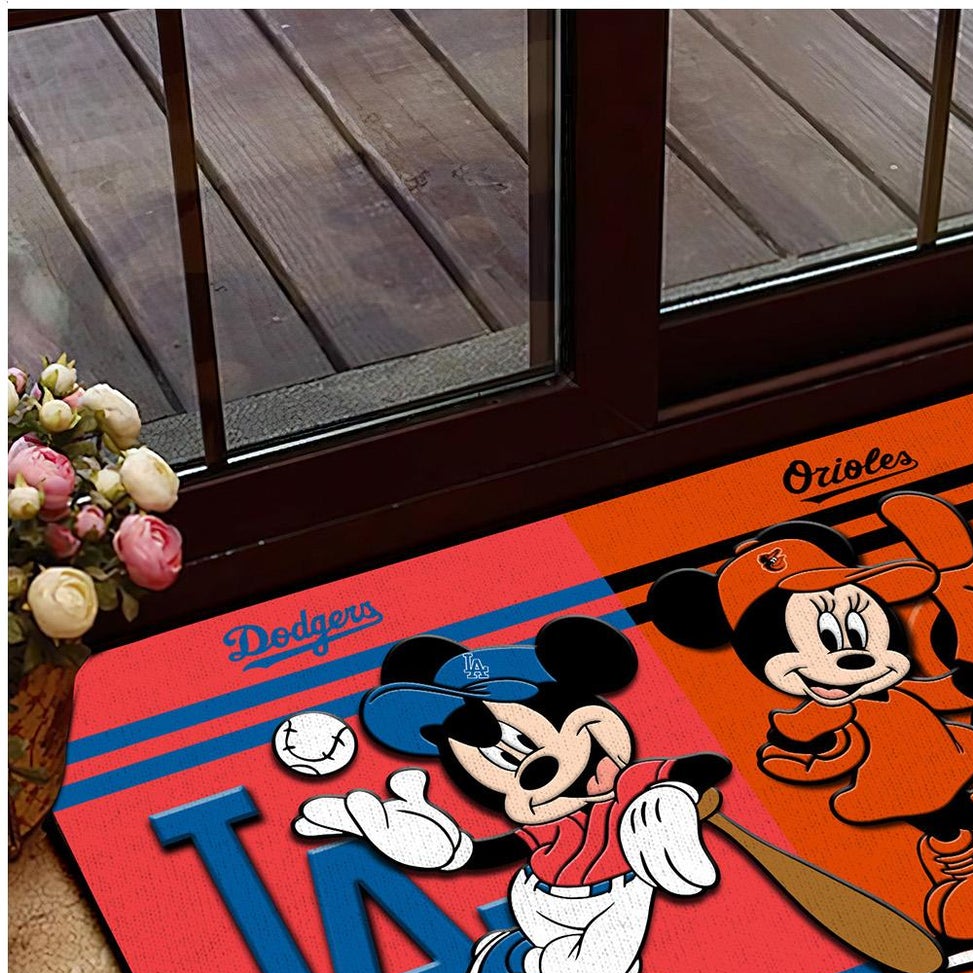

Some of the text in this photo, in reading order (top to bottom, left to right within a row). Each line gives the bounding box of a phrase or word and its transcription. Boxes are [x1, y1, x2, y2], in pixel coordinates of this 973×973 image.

[782, 447, 919, 501] Orioles
[222, 598, 384, 668] Dodgers
[462, 652, 489, 679] LA
